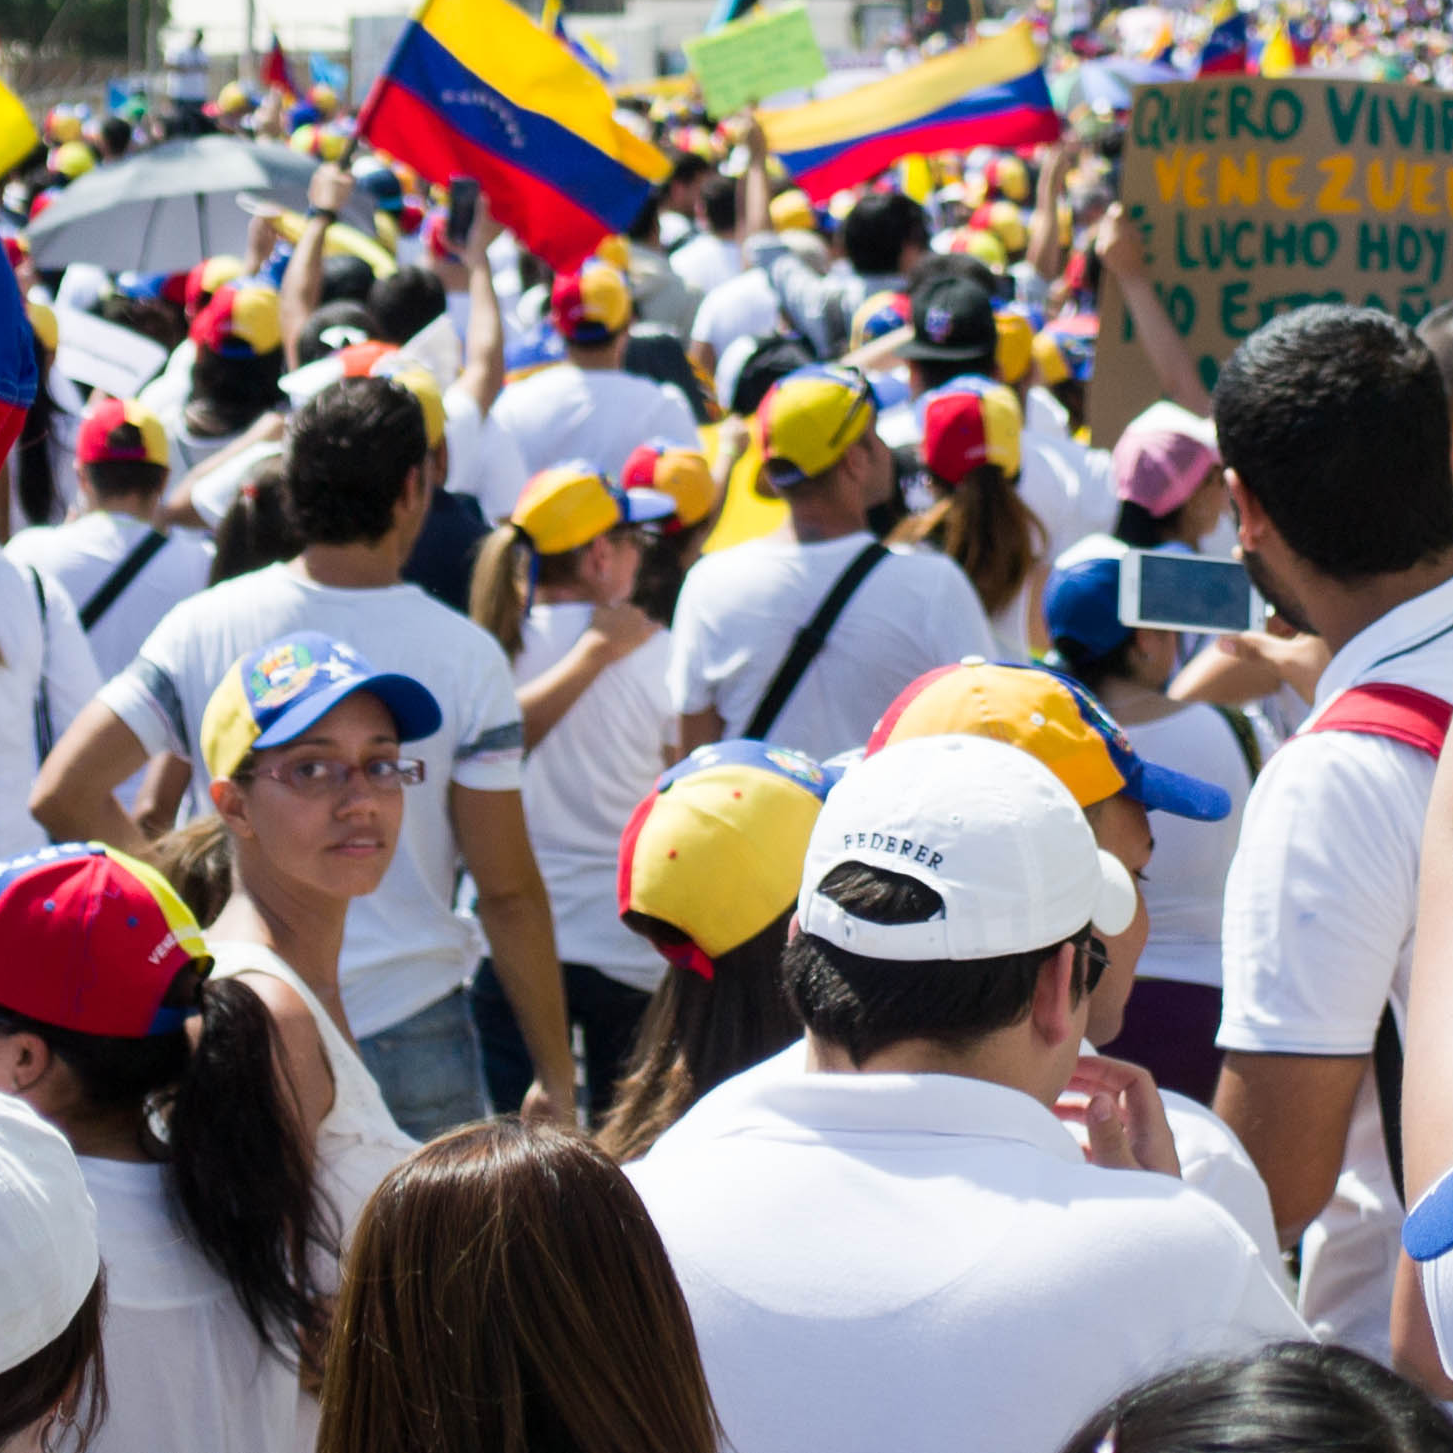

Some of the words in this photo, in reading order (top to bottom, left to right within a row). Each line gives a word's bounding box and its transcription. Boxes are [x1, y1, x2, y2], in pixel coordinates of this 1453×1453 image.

[1134, 85, 1304, 148] QUIERO
[1176, 211, 1338, 272] LUCHO
[1357, 221, 1446, 283] HOY
[843, 833, 945, 871] FEDERER
